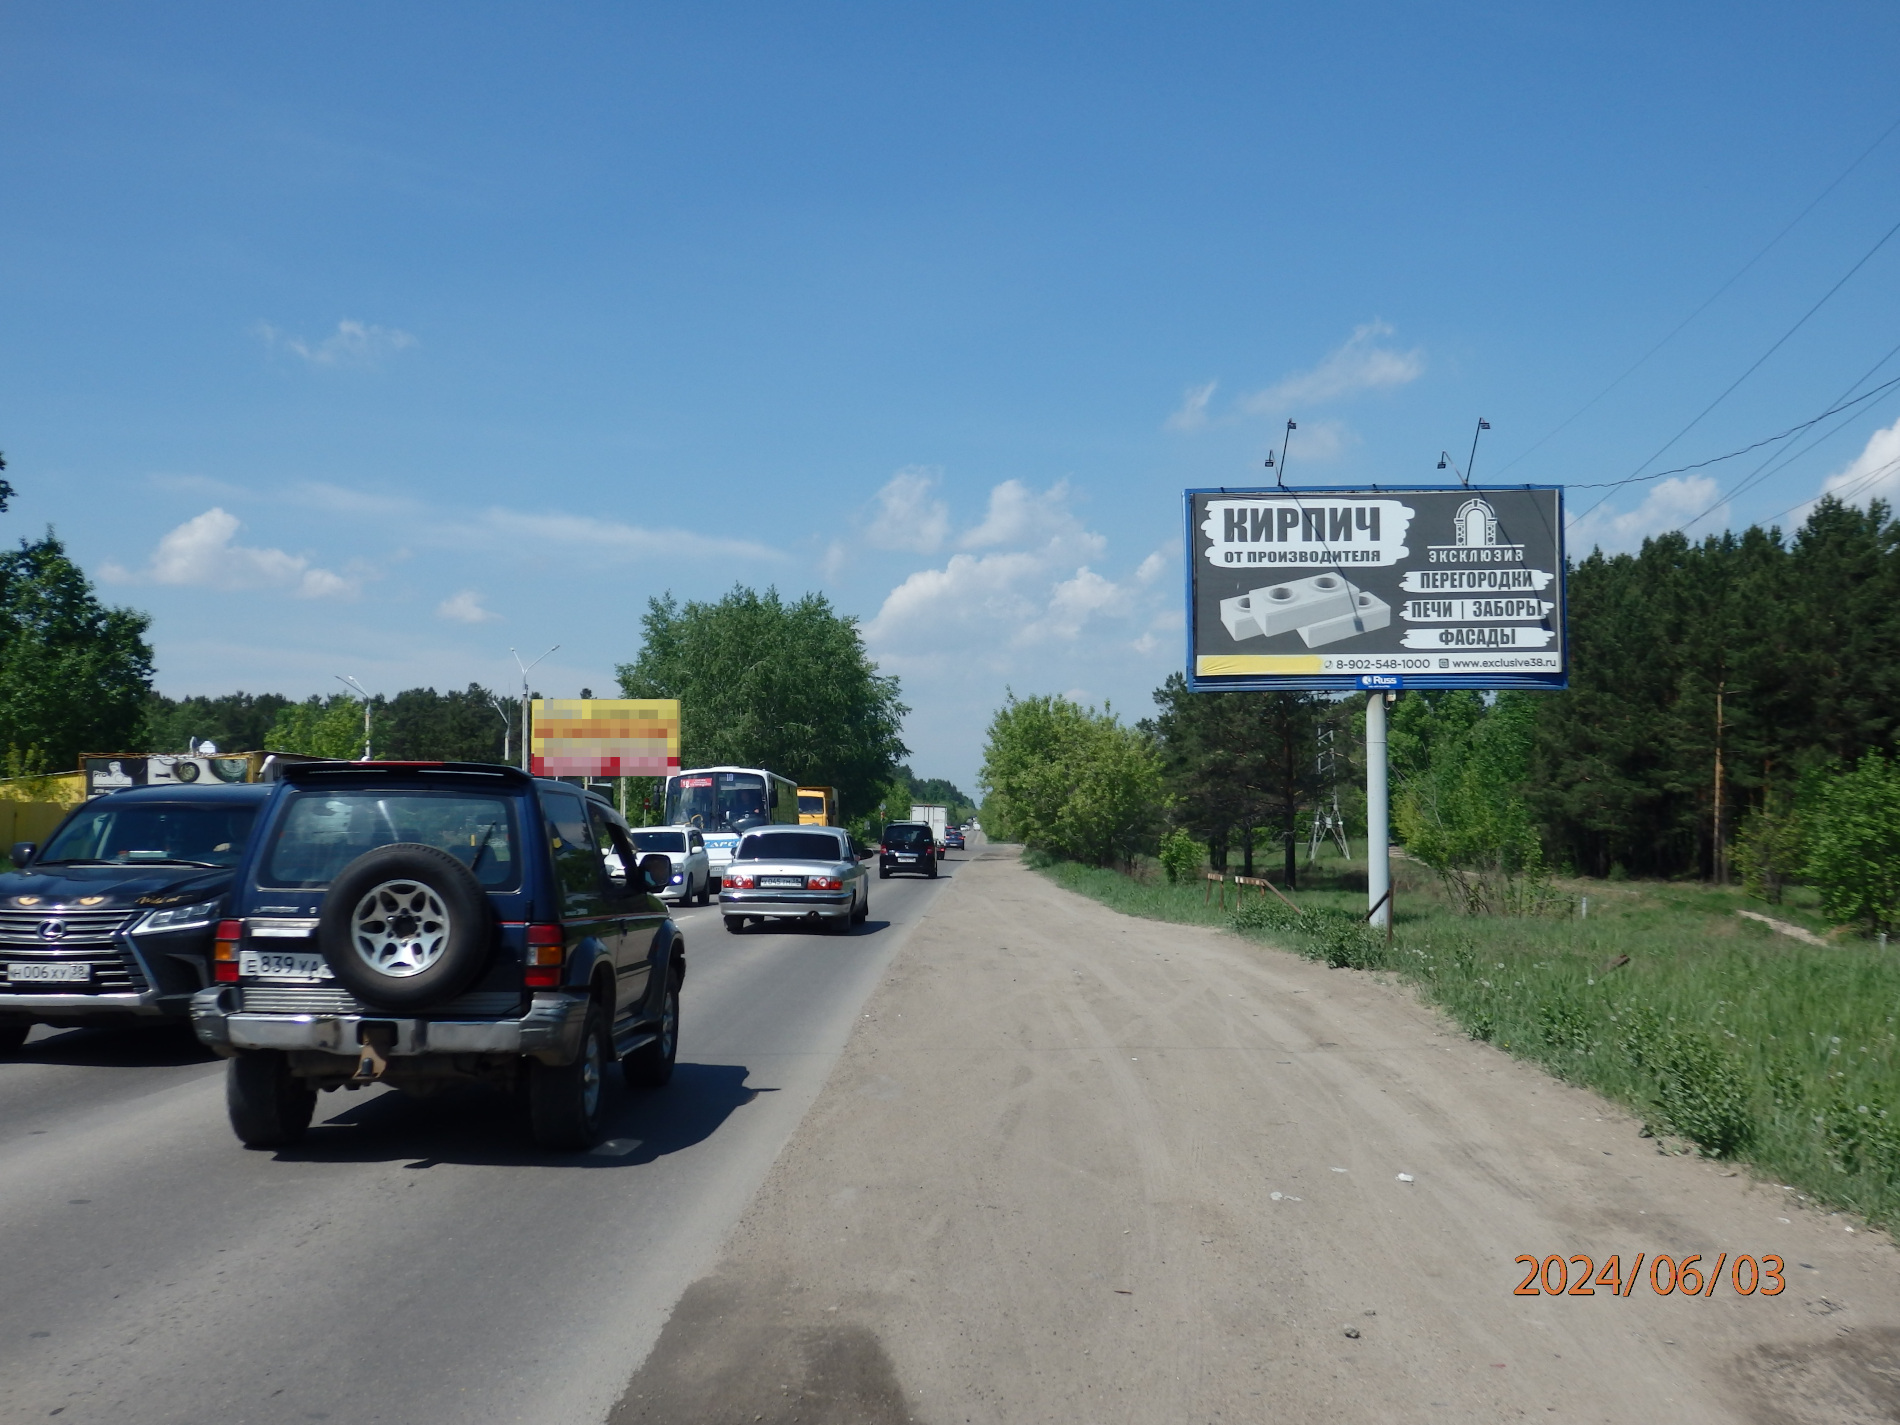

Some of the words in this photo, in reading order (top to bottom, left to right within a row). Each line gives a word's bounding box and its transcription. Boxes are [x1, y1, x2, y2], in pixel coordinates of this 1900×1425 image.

[1224, 507, 1380, 543] КИРПИЧ
[1224, 551, 1243, 563] ОТ
[1247, 550, 1380, 564] ПРОИЗВОДИТЕЛЯ
[1428, 550, 1524, 563] ЭКСКЛЮЗИВ
[1420, 570, 1533, 590] ПЕРЕГОРОДКИ
[1411, 601, 1453, 618] ПЕЧИ
[1472, 600, 1542, 617] ЗАБОРЫ
[1439, 628, 1516, 647] ФАСАДЫ
[1336, 659, 1430, 669] 8-902-548-1000
[1453, 657, 1556, 667] www.exclusive38.ru
[1373, 676, 1397, 684] Russ
